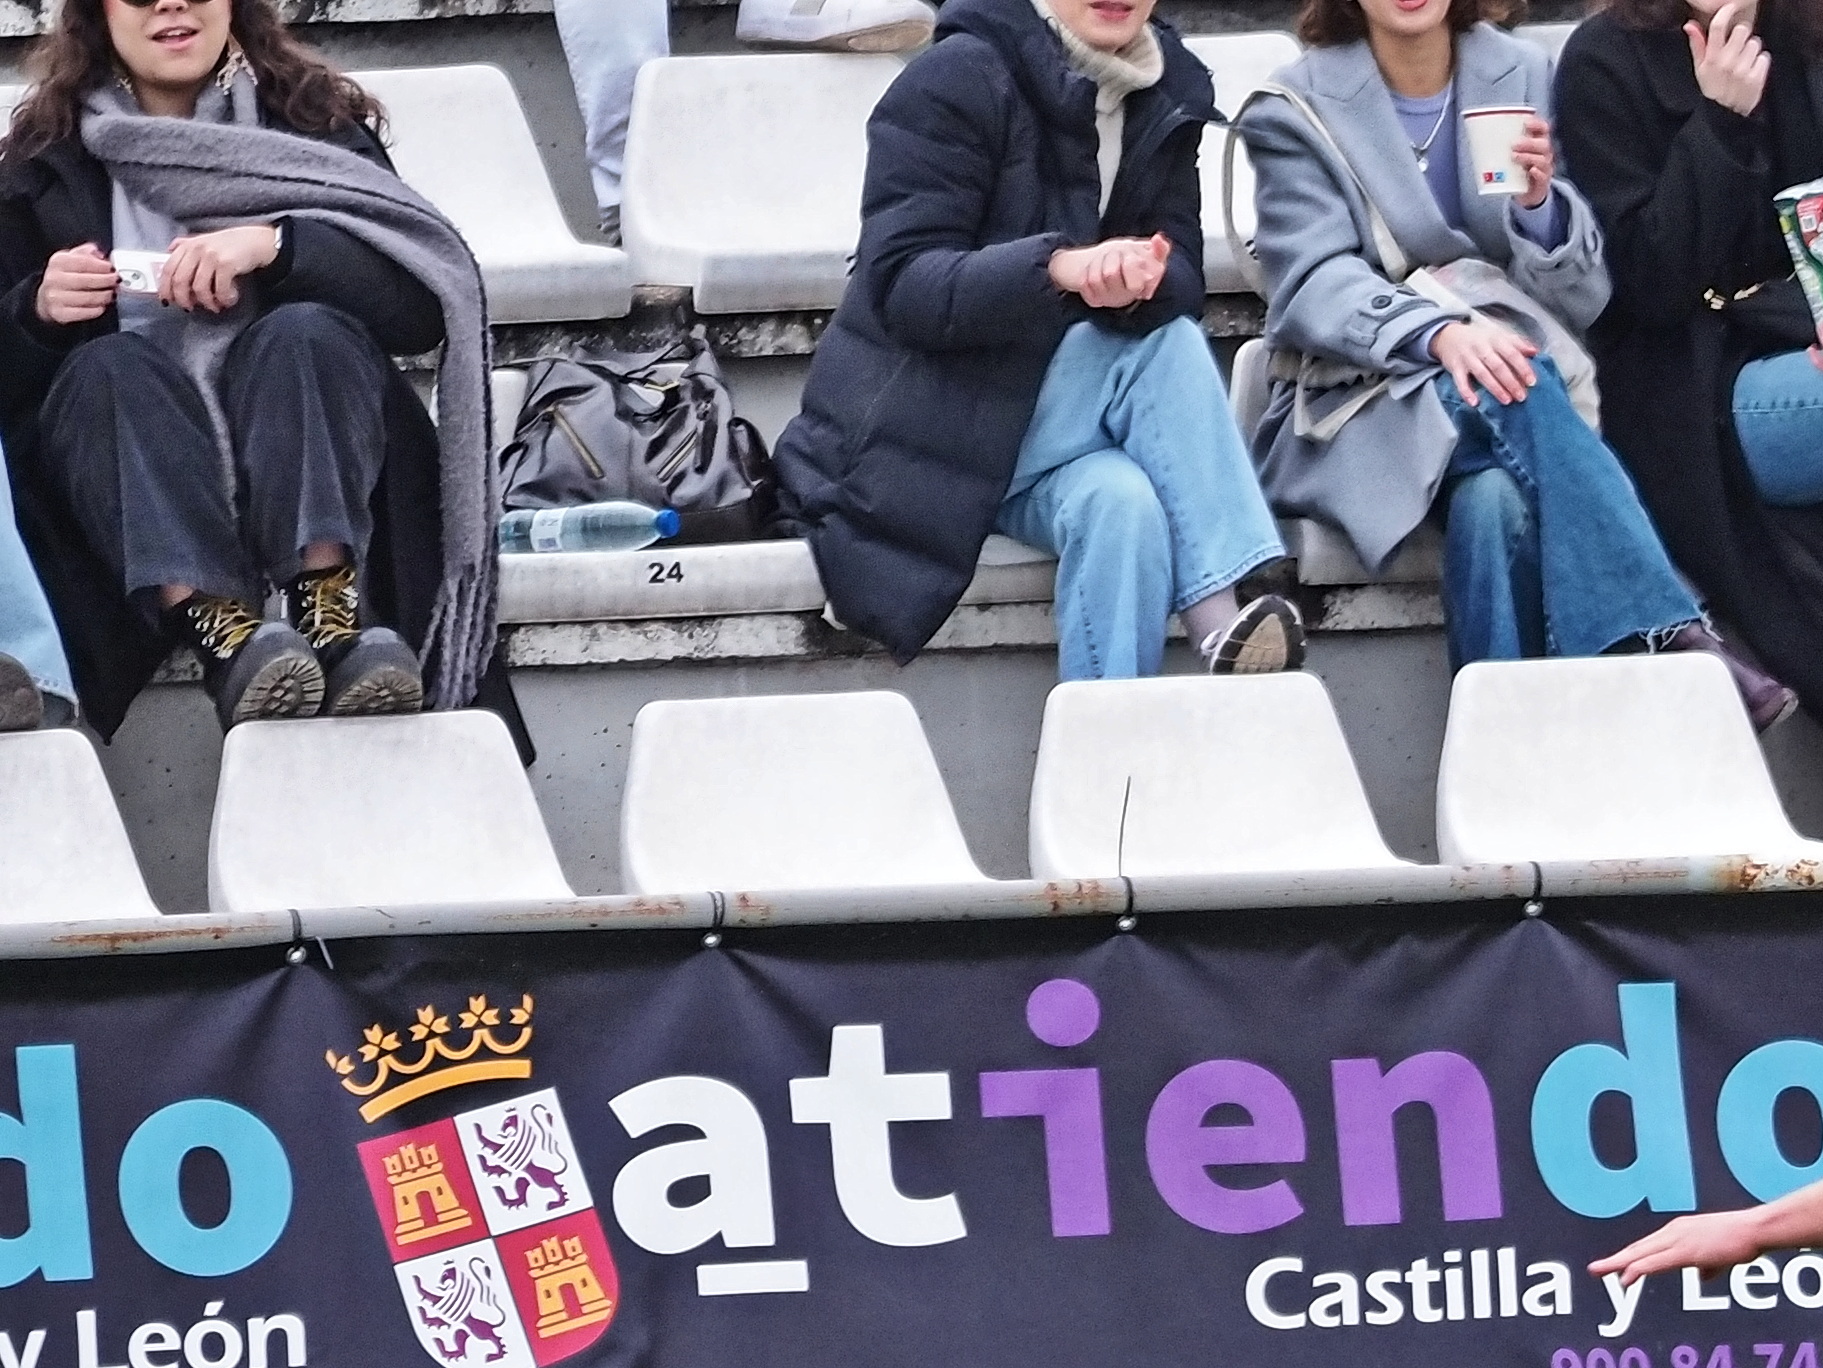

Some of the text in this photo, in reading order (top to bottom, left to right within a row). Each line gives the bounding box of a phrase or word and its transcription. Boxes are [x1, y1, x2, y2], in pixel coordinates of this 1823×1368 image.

[648, 561, 683, 583] 24
[1245, 1246, 1573, 1330] Castilla
[1598, 1272, 1646, 1338] y
